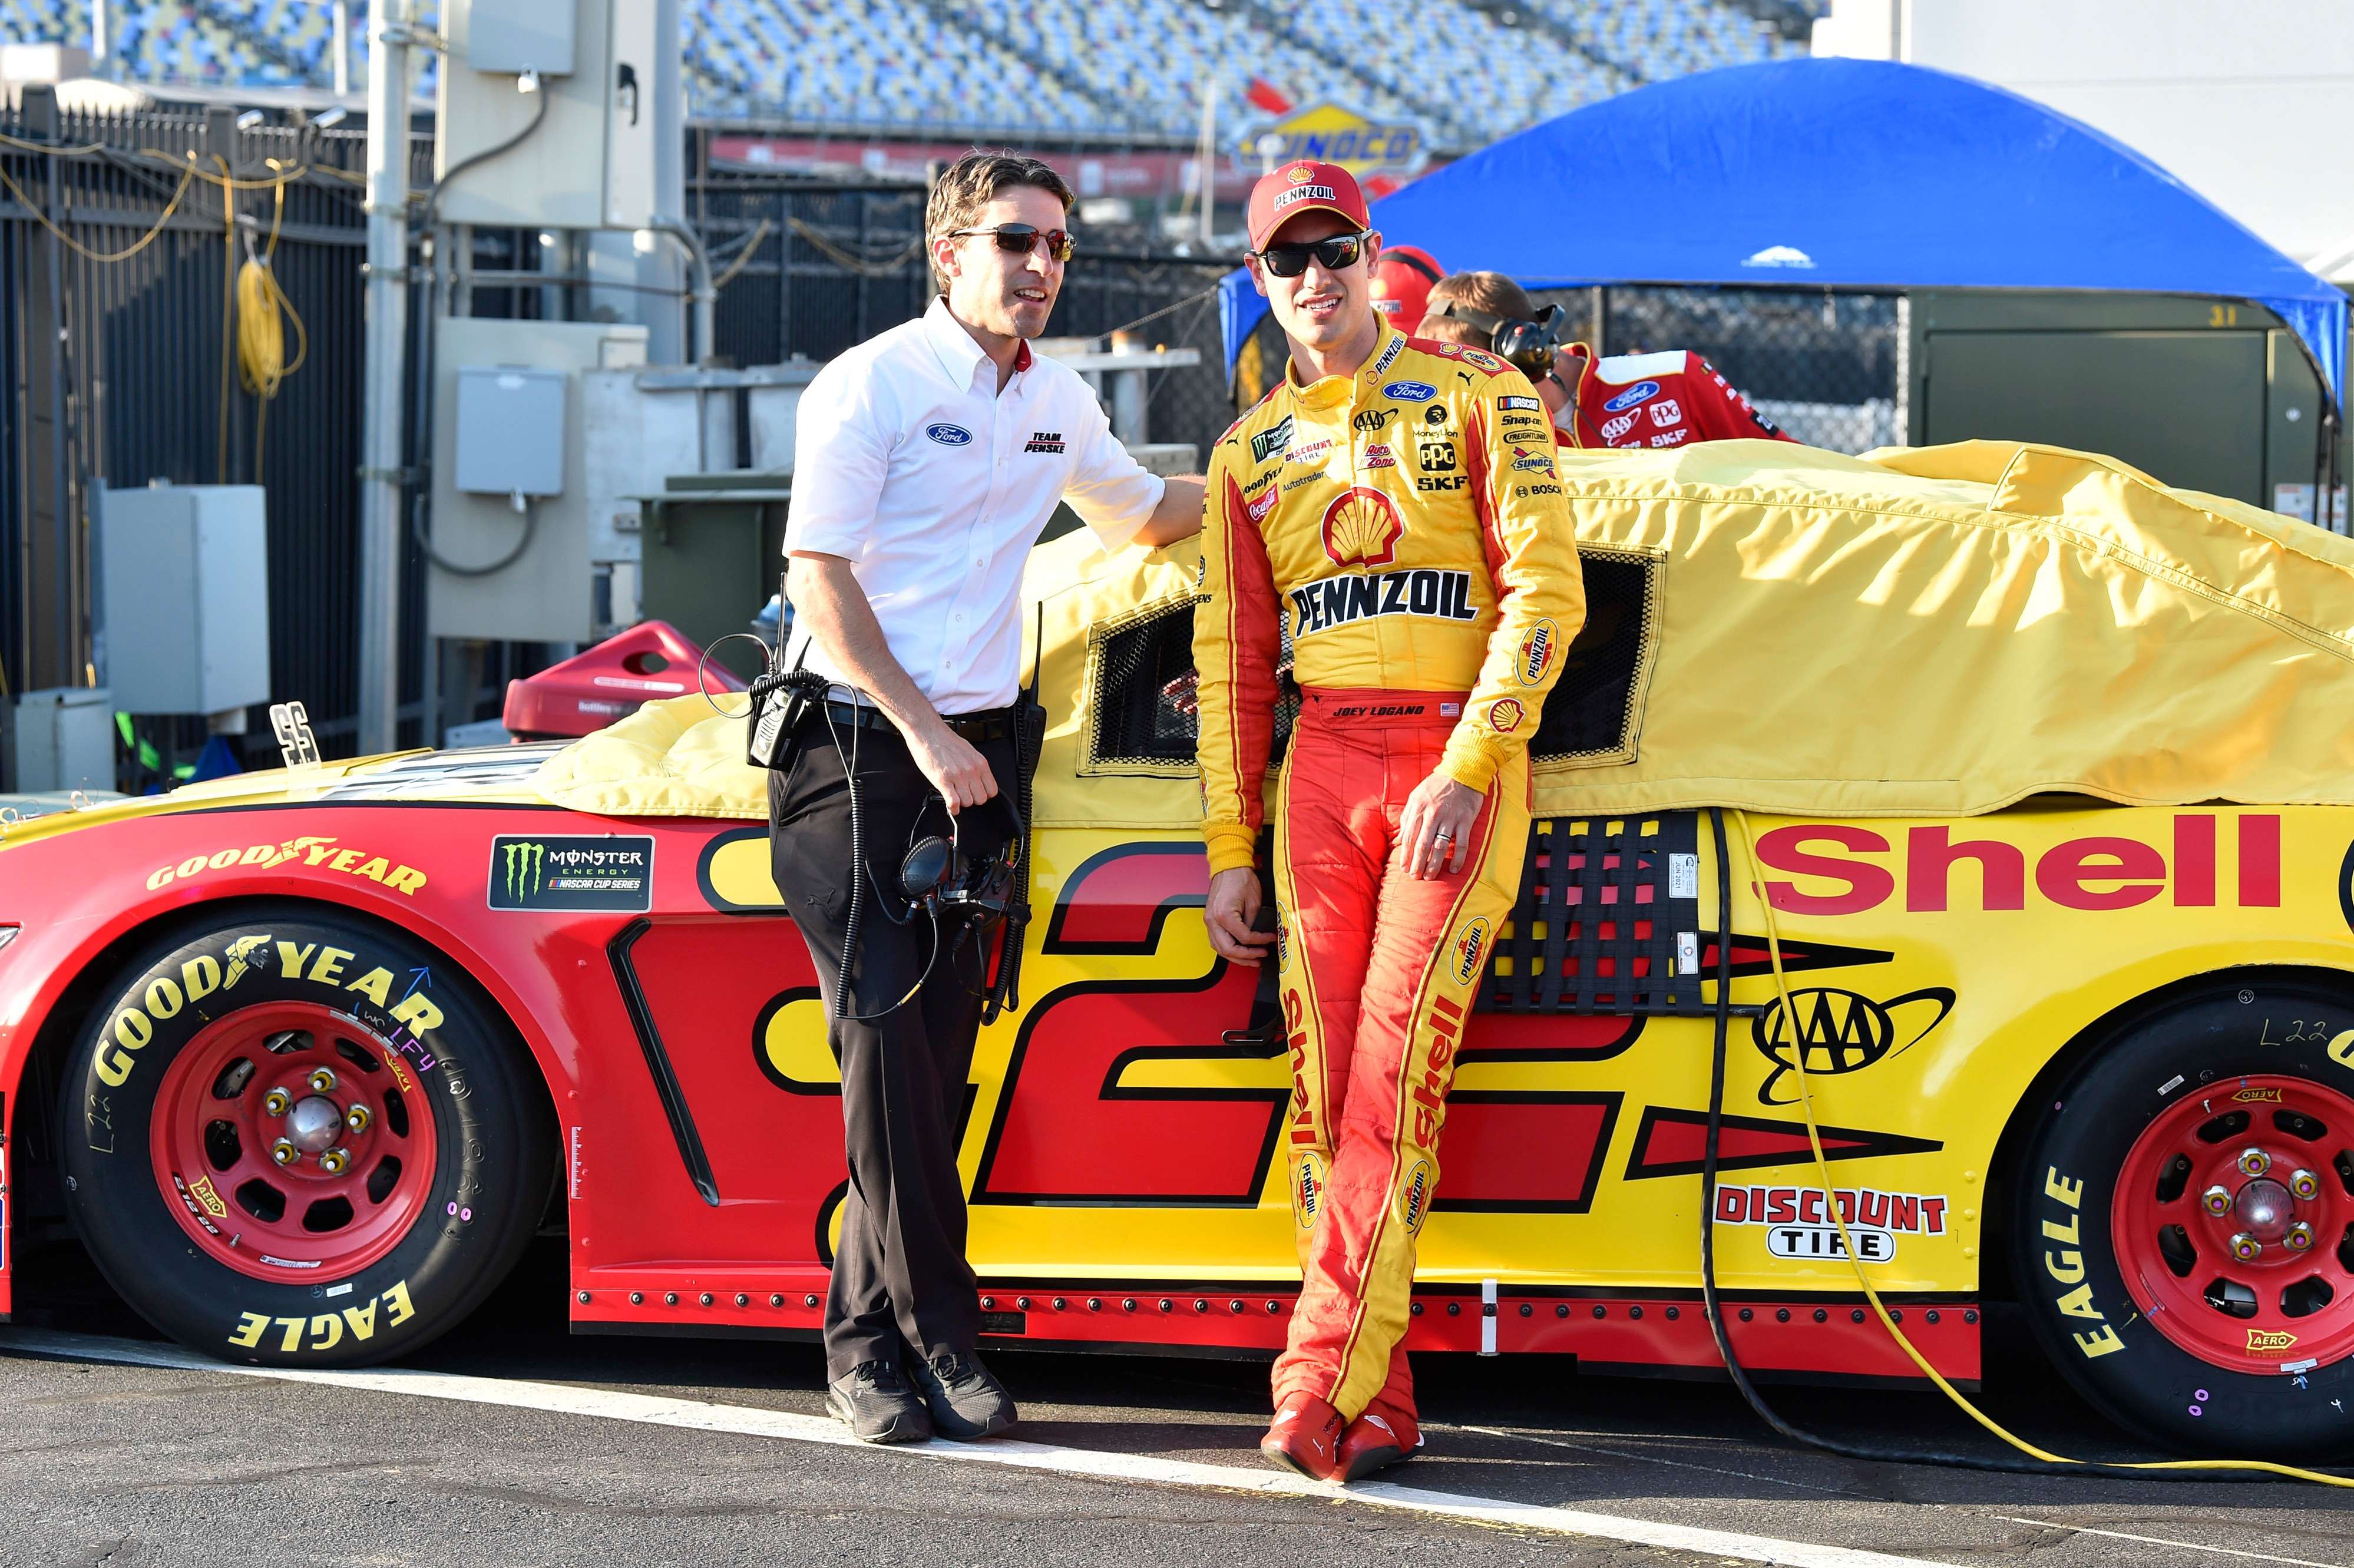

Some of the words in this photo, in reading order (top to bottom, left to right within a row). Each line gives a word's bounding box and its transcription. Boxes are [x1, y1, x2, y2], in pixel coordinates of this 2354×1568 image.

[1275, 186, 1335, 210] PENNZOIL
[1374, 334, 1405, 375] PENNZOIL
[1466, 351, 1496, 367] PENNZOIL
[1393, 383, 1427, 398] Ford
[1616, 386, 1649, 408] Ford
[1510, 397, 1538, 411] NASCAR
[1653, 404, 1679, 423] PPG
[1355, 411, 1381, 430] AAA
[1501, 415, 1542, 426] Snap-on
[1604, 418, 1629, 437] AAA
[935, 426, 963, 442] Ford
[1033, 432, 1062, 441] TEAM
[1413, 429, 1459, 438] MoneyLion
[1509, 433, 1546, 441] FREIGHTLINER
[1651, 428, 1687, 448] SKF
[1024, 444, 1066, 454] PENSKE
[1285, 439, 1333, 462] DISCOUNT
[1298, 451, 1320, 463] TIRE
[1366, 445, 1389, 455] Auto
[1420, 445, 1454, 469] PPG
[1367, 457, 1395, 468] Zone
[1516, 459, 1554, 468] SUNOCO
[1283, 471, 1325, 492] Autotrader
[1417, 476, 1468, 491] SKF
[1531, 485, 1562, 496] BOSCH
[1289, 569, 1480, 639] PENNZOIL
[1527, 626, 1550, 679] PENNZOIL
[1333, 707, 1367, 717] JOEY
[1370, 706, 1425, 716] LOGANO
[549, 849, 644, 866] MONSTER
[1753, 814, 2280, 917] Shell
[146, 845, 428, 896] GOODYEAR
[559, 879, 593, 889] NASCAR
[593, 879, 611, 889] CUP
[610, 880, 641, 889] SERIES
[1460, 925, 1483, 979] PENNZOIL
[1768, 990, 1877, 1071] AAA
[1283, 987, 1317, 1144] Shell
[1413, 995, 1463, 1153] Shell
[2242, 1090, 2273, 1099] AERO
[197, 1186, 221, 1212] AERO
[1302, 1163, 1318, 1221] PENNZOIL
[1406, 1170, 1424, 1227] PENNZOIL
[1715, 1186, 1945, 1233] DISCOUNT
[1781, 1230, 1880, 1257] TIRE
[2042, 1165, 2126, 1358] EAGLE
[228, 1279, 416, 1352] EAGLE
[2253, 1336, 2287, 1345] AERO
